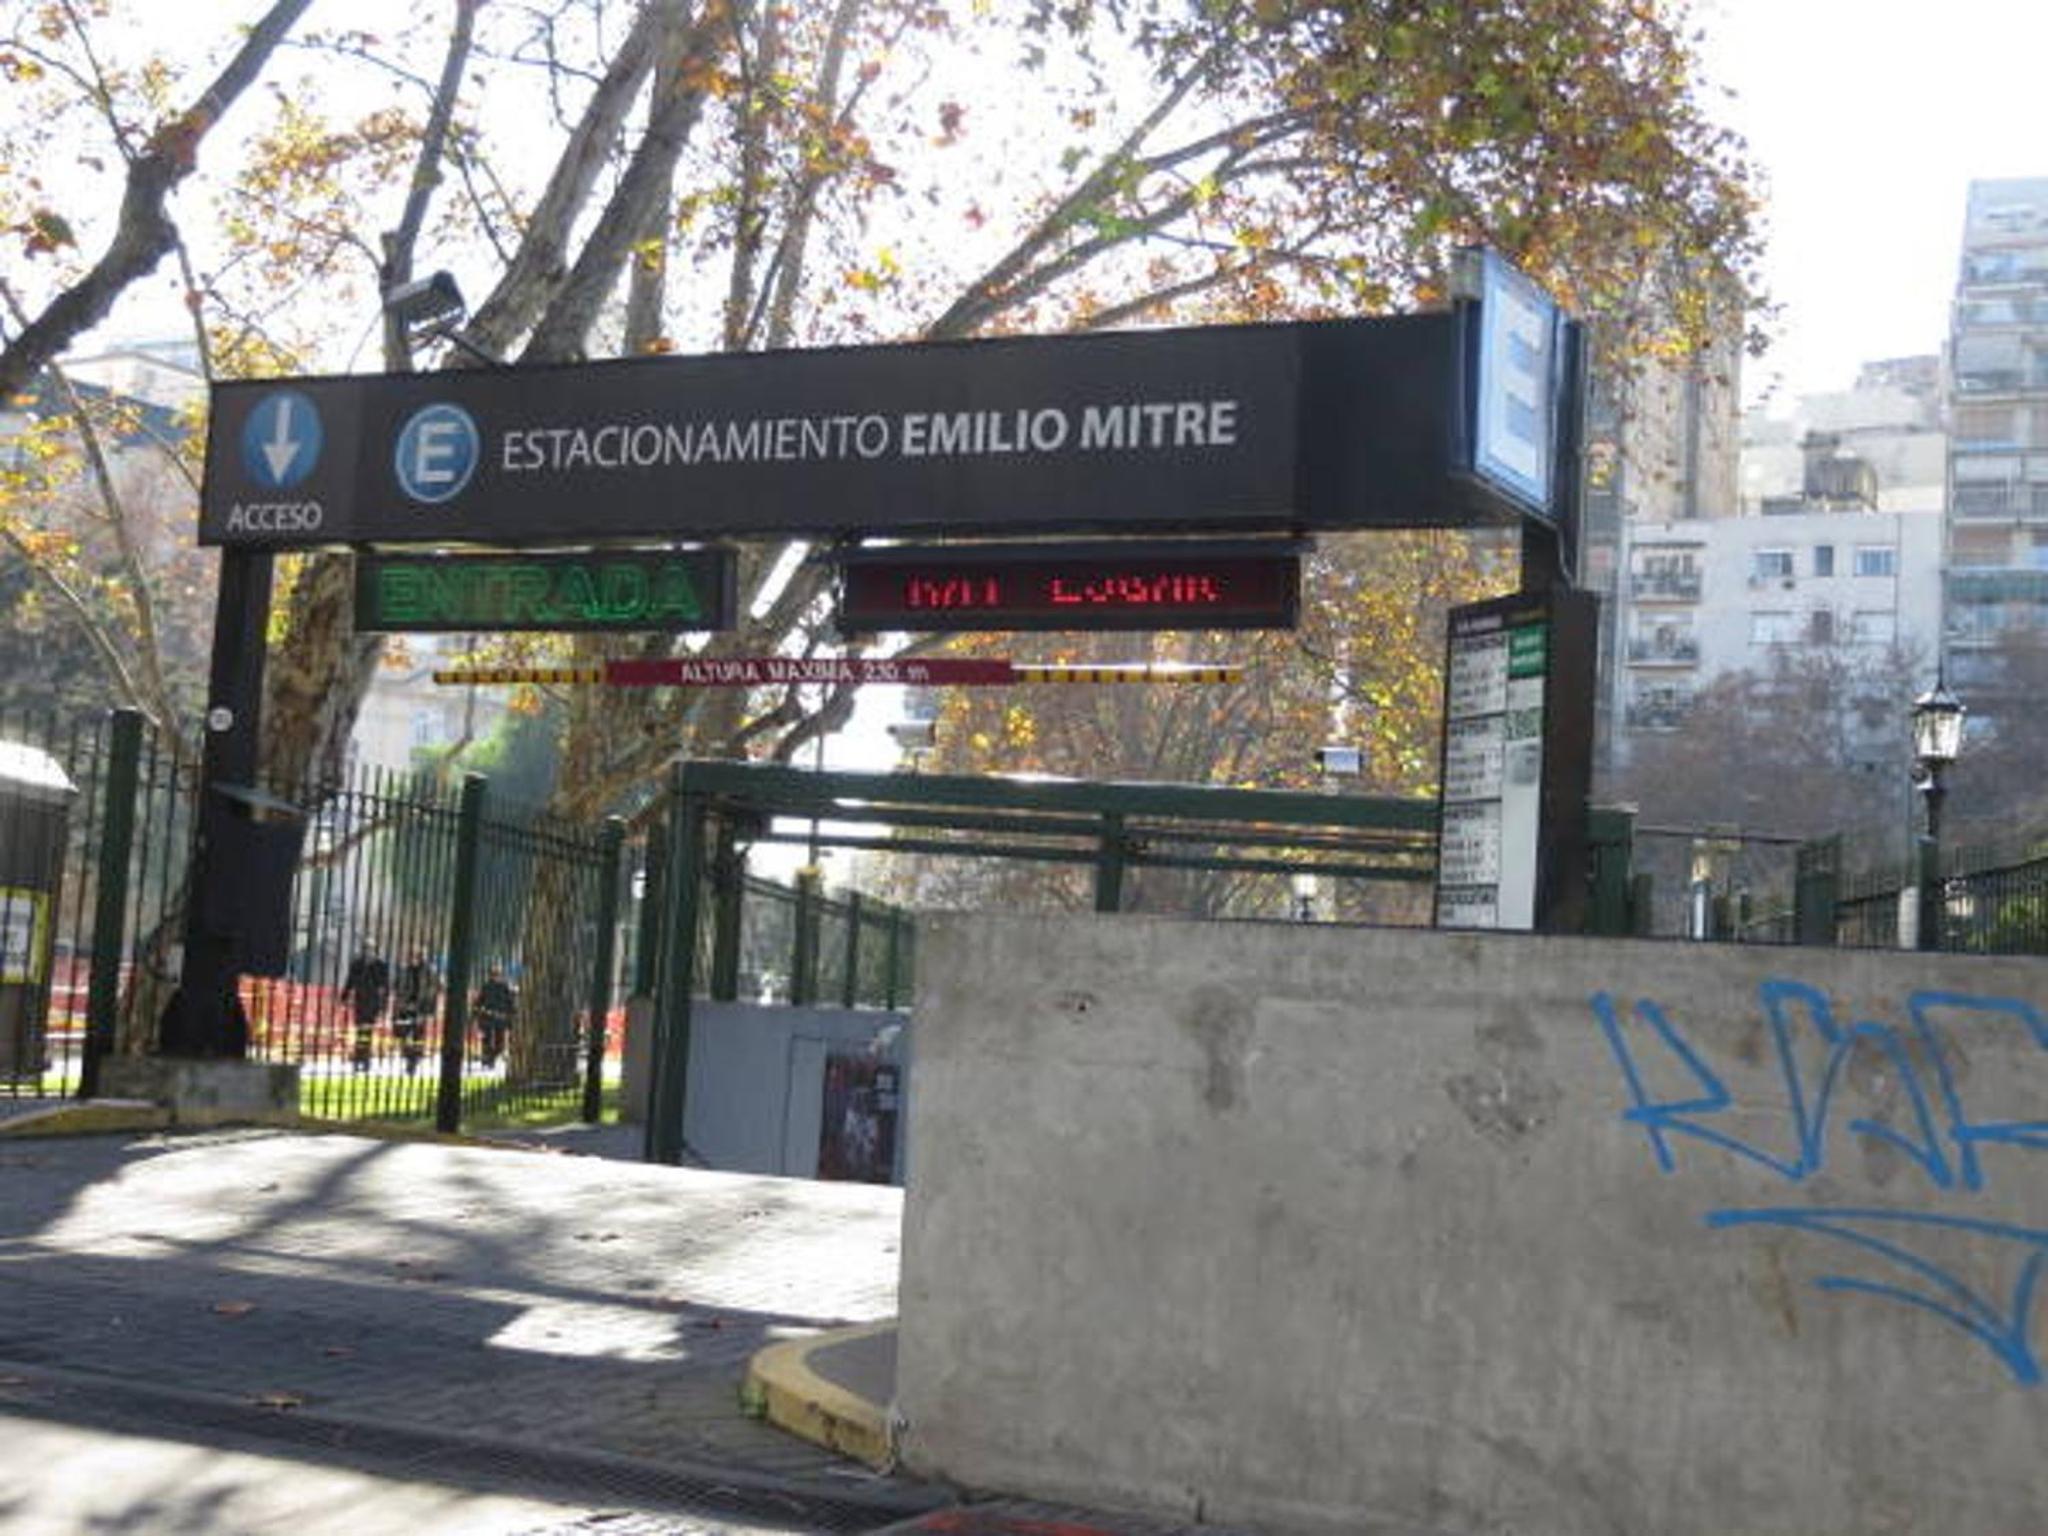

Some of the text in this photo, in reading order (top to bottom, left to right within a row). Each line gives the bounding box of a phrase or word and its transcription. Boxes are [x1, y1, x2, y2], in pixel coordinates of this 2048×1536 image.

[413, 421, 462, 483] E
[502, 400, 1239, 471] ESTACIONAMIENTO EMILIO MITRE
[227, 503, 323, 533] ACCESO
[380, 564, 701, 623] ENTRADA
[680, 659, 761, 683] ALTURA
